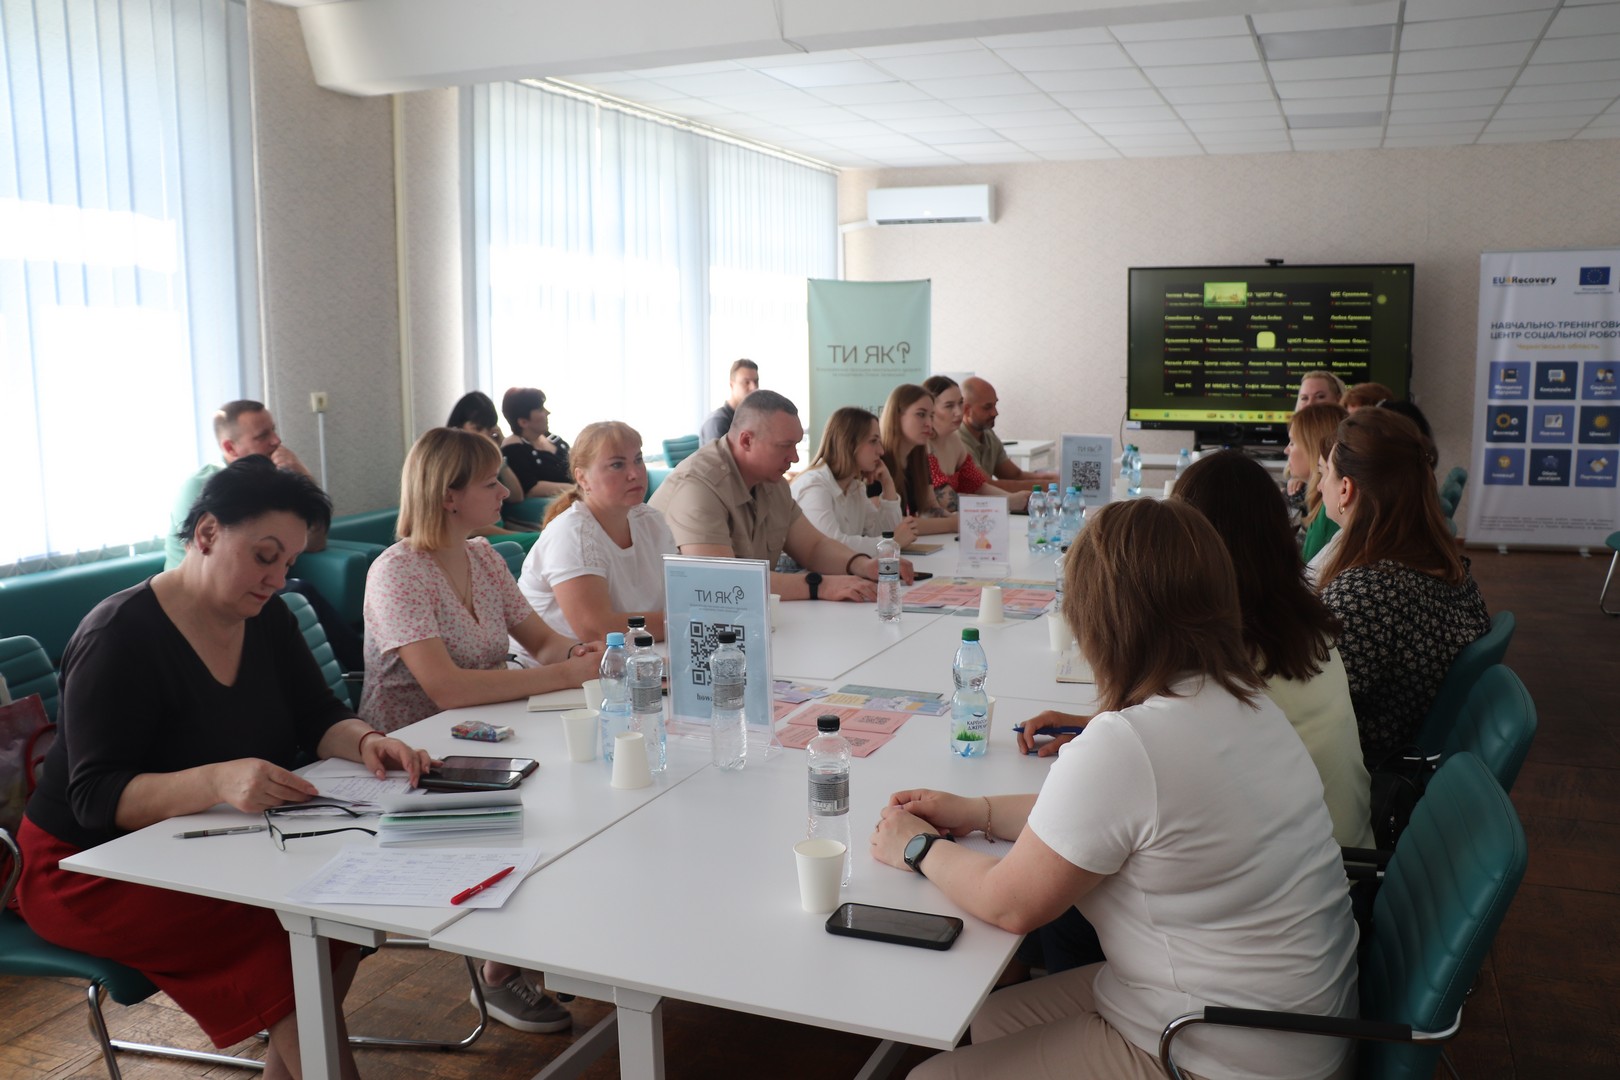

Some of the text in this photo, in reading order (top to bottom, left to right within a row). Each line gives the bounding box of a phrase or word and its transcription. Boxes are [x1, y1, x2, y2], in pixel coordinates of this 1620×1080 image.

[1490, 330, 1522, 340] ЦЕНТР
[1524, 329, 1587, 340] СОЦІАЛЬНОЇ
[827, 341, 911, 364] ТИ ЯК?
[694, 585, 745, 605] ТИ ЯК?
